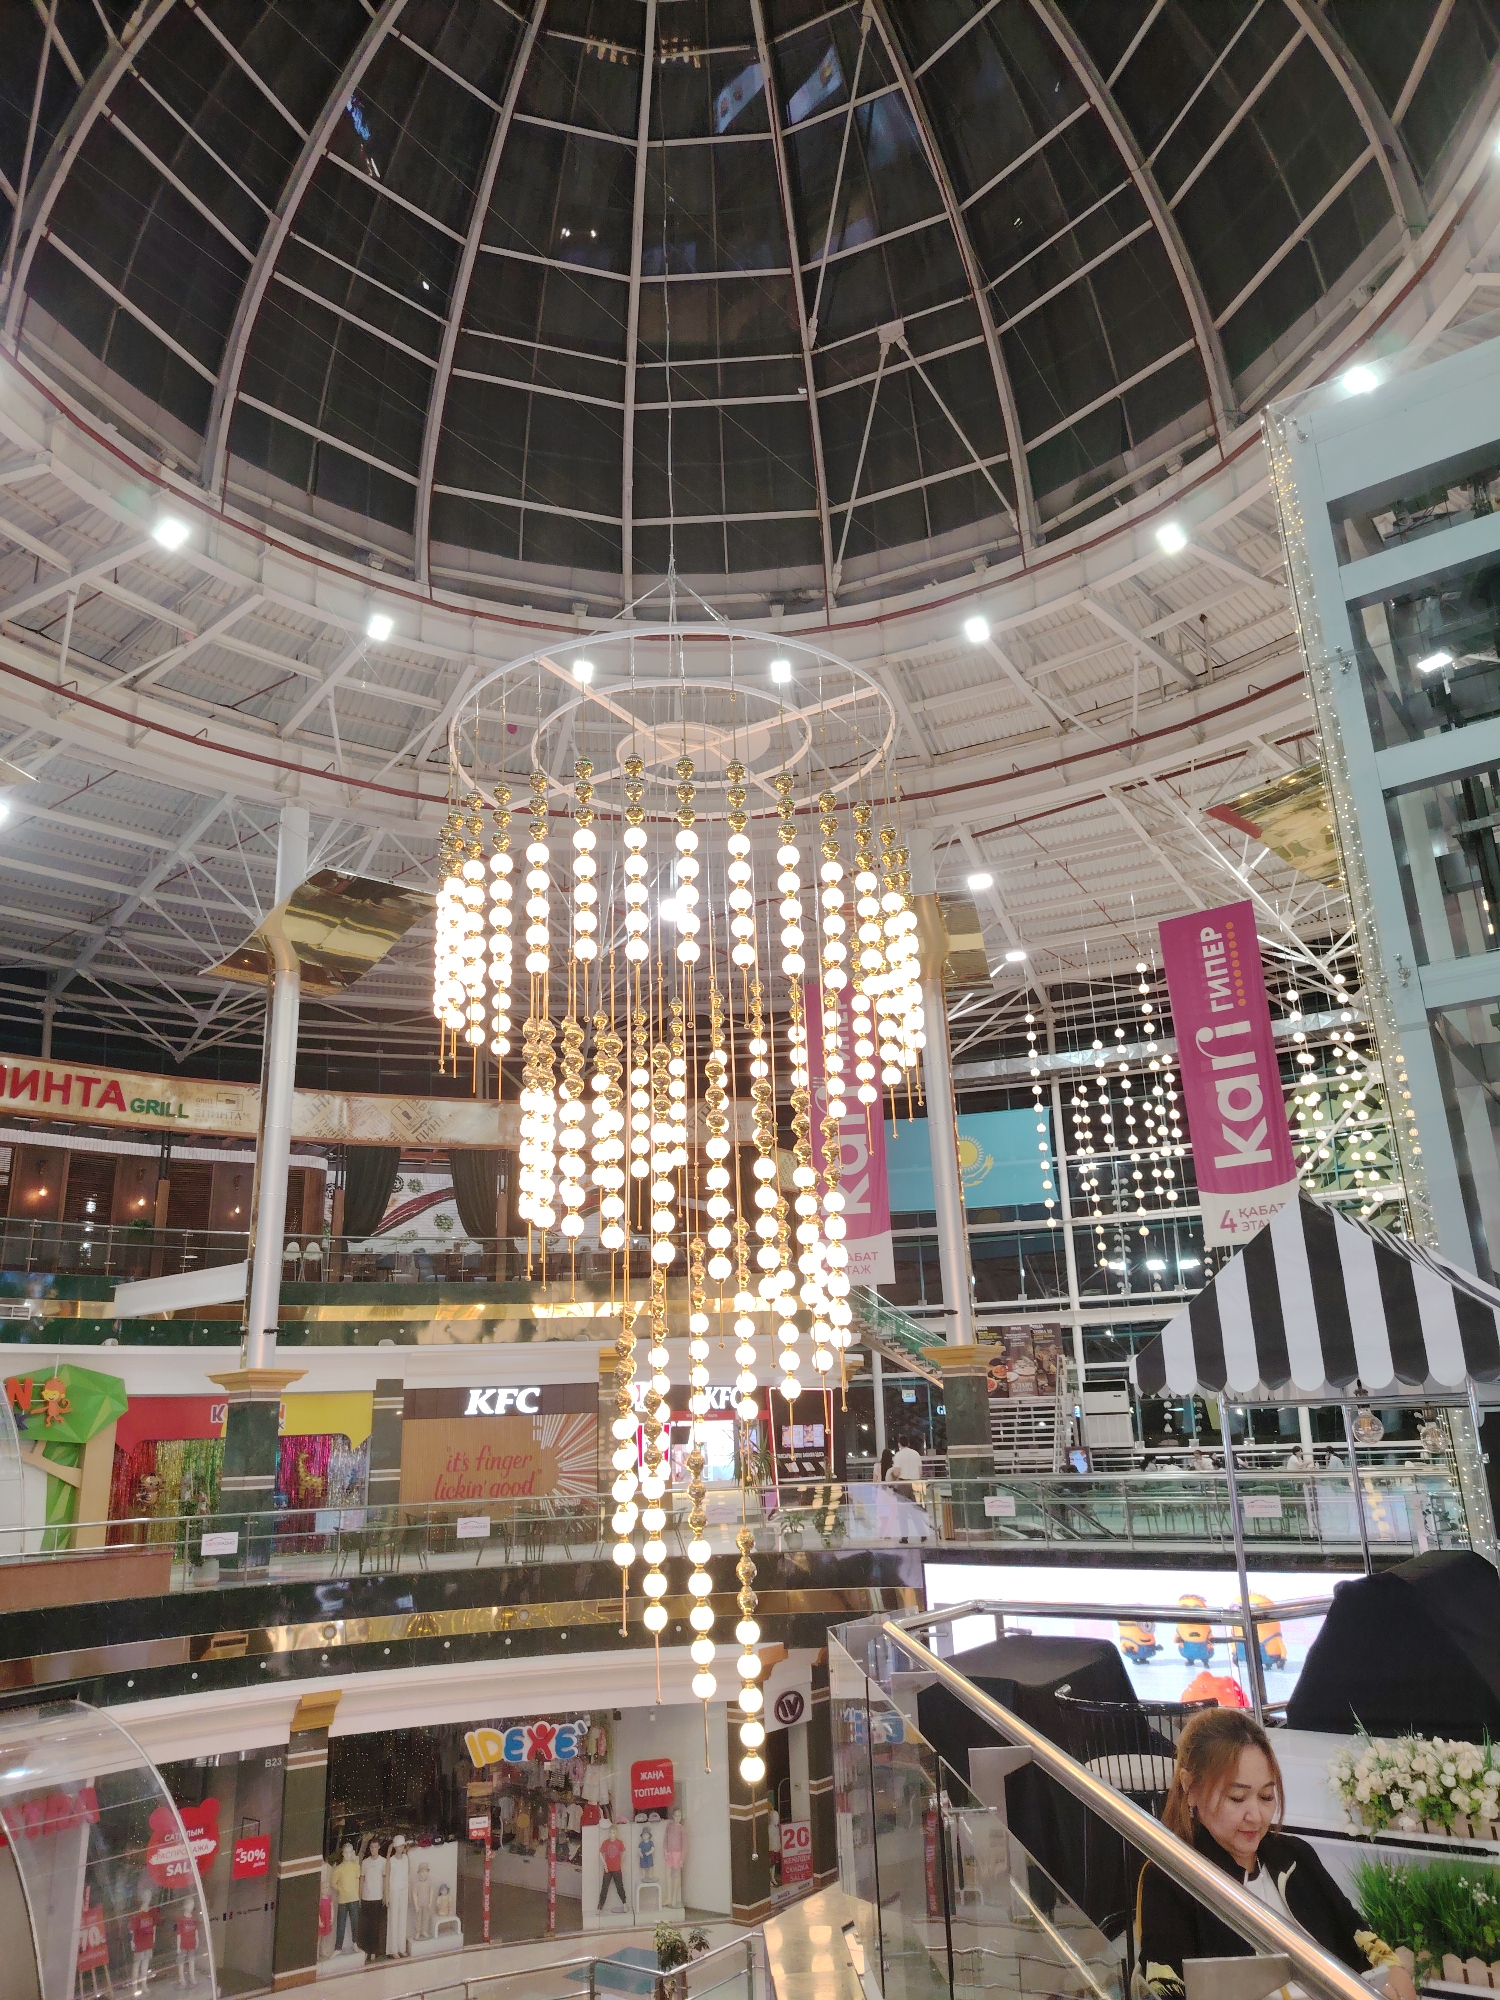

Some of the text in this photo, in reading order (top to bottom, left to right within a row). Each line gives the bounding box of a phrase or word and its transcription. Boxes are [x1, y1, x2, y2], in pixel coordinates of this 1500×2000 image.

[1200, 925, 1234, 1013] ГИПЕР
[1196, 1020, 1273, 1169] kari
[130, 1098, 189, 1119] GRILL
[1220, 1210, 1237, 1233] 4
[1242, 1219, 1270, 1231] ЭТА
[848, 1252, 878, 1262] АБАТ
[843, 1265, 871, 1274] ТАЖ
[464, 1387, 541, 1415] KFC
[704, 1386, 743, 1410] KFC
[476, 1445, 533, 1478] finger
[265, 1757, 282, 1767] B23
[634, 1786, 672, 1798] ТОПТАМА
[156, 1844, 209, 1861] РАСПРОАЖА
[236, 1849, 266, 1864] -50%
